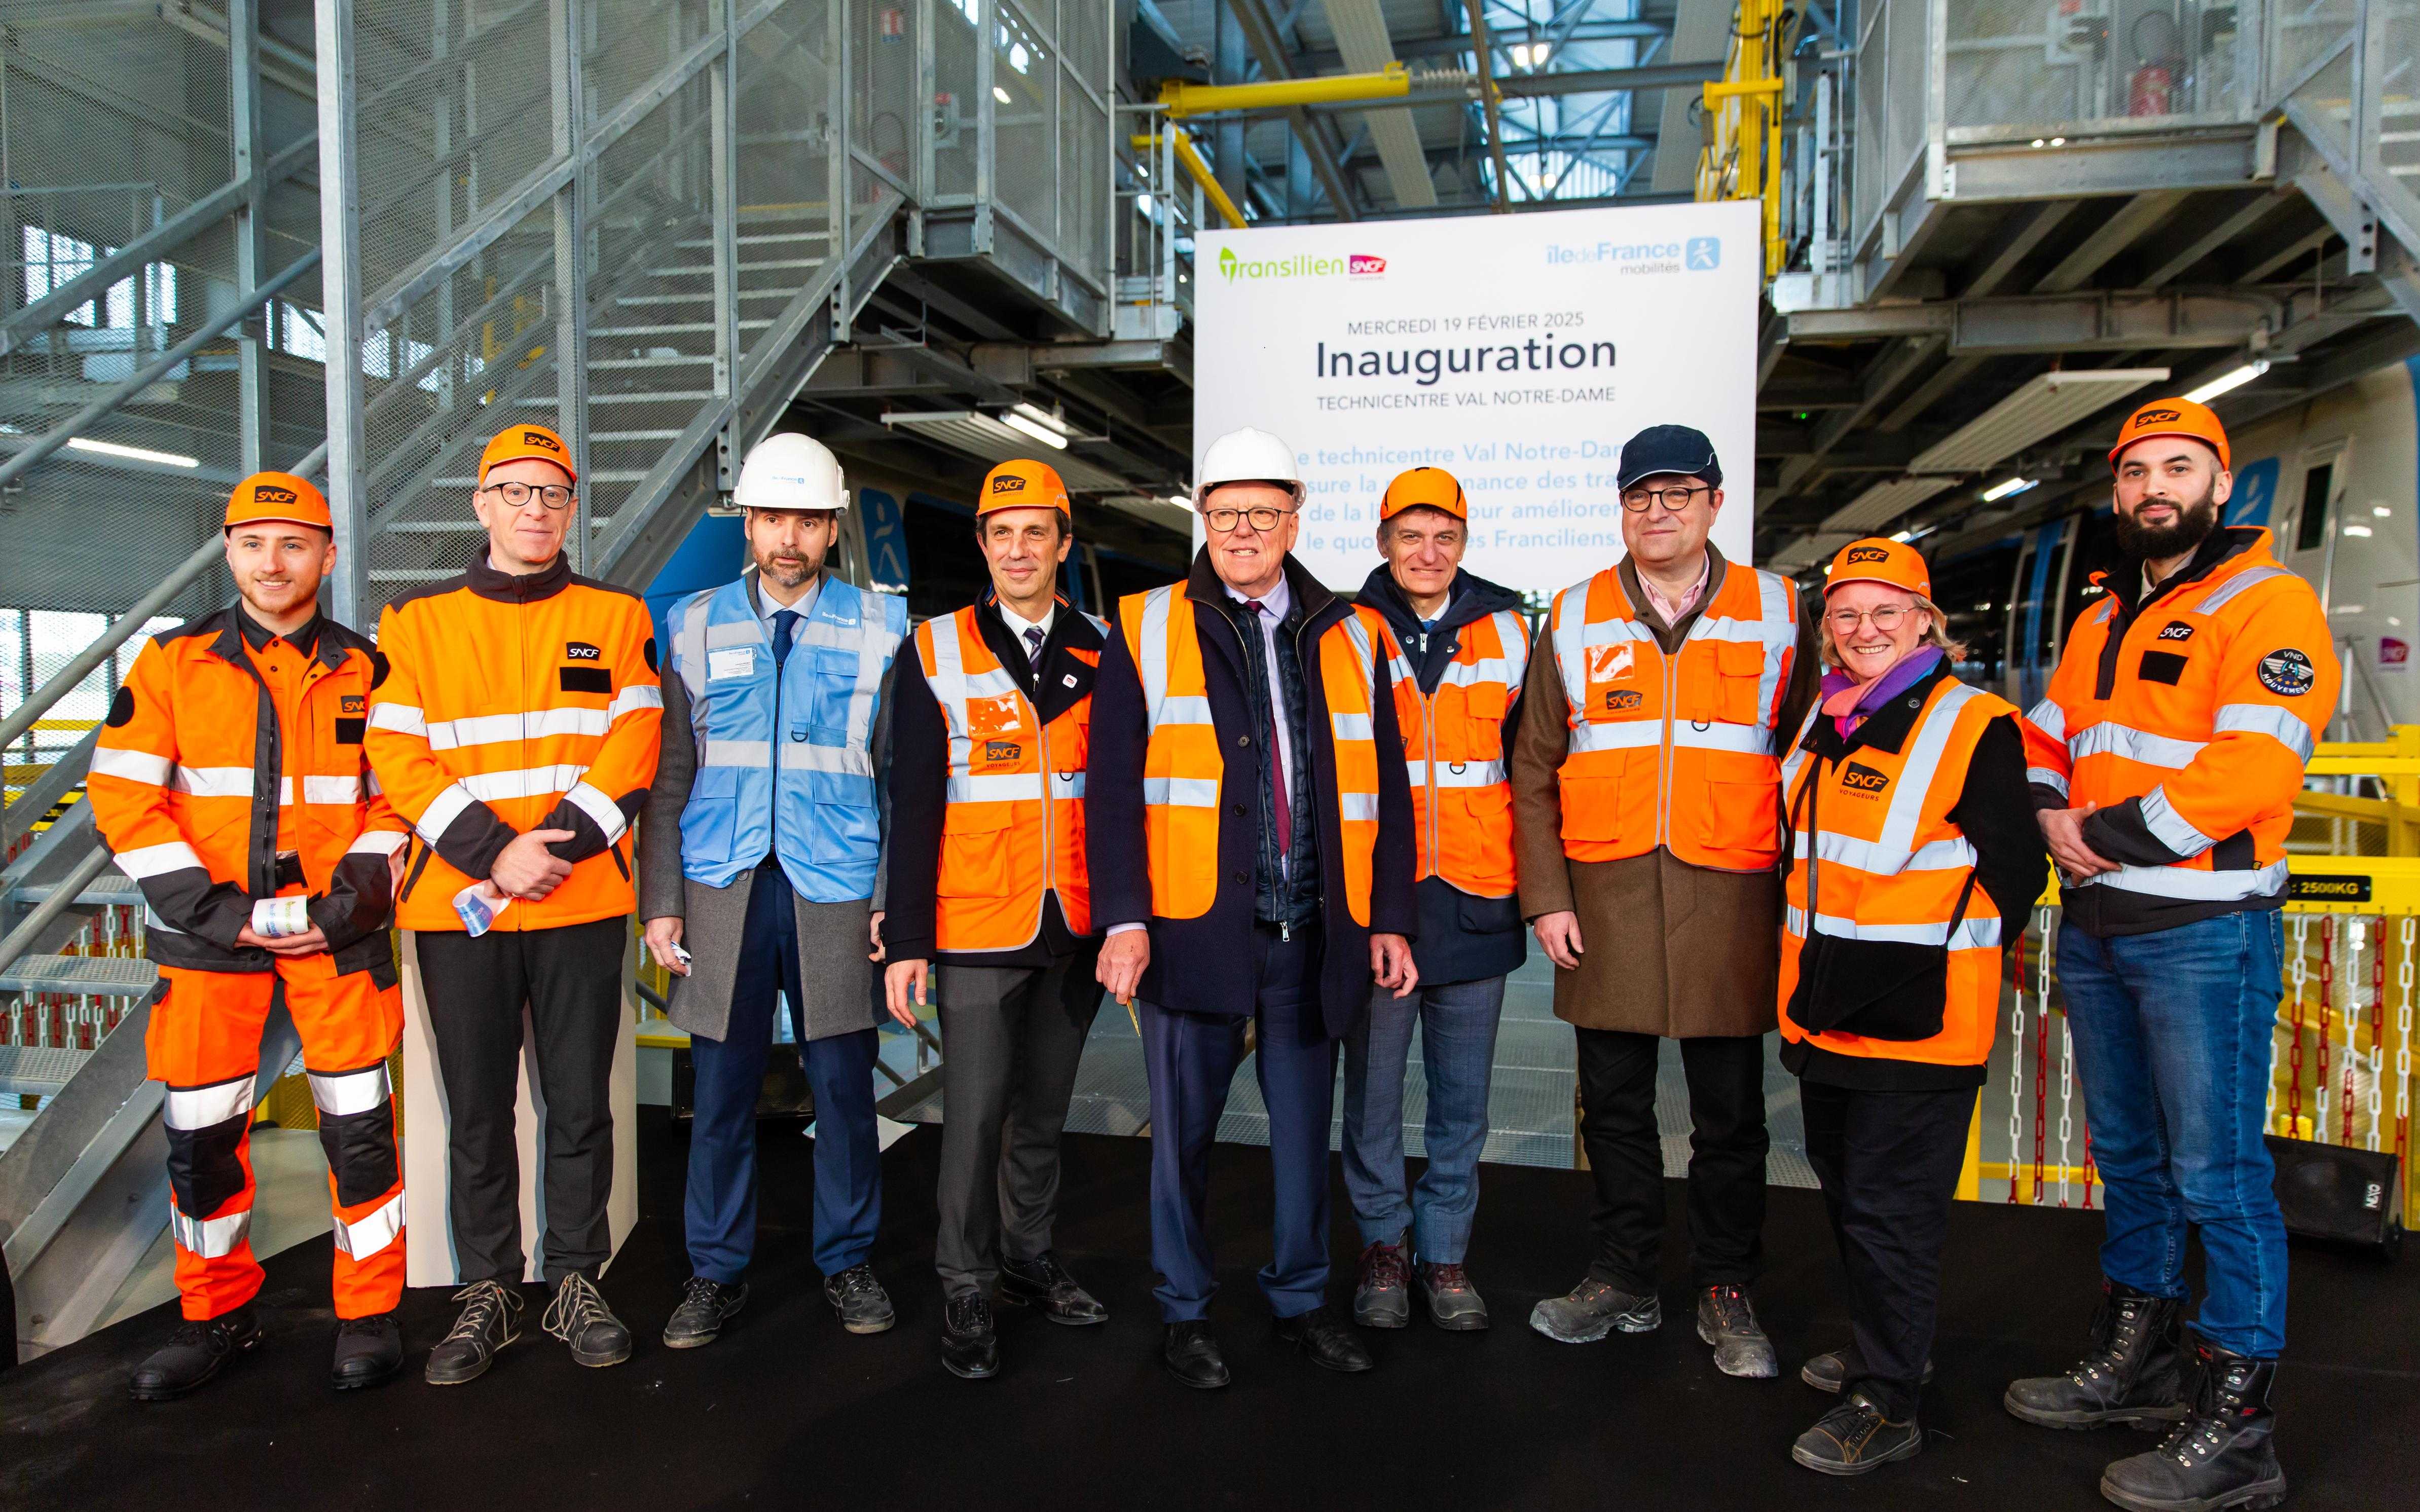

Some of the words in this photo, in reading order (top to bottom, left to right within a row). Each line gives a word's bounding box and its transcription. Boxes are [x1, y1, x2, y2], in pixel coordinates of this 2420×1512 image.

[1218, 246, 1343, 284] Transilien
[1350, 259, 1386, 274] SNCF
[1621, 261, 1680, 276] mobilités
[1347, 319, 1436, 335] MERCREDI
[1444, 318, 1461, 331] 19
[1468, 314, 1537, 330] FÉVRIER
[1544, 311, 1584, 328] 2025
[1317, 333, 1616, 385] Inauguration
[1317, 393, 1450, 410] TECHNICENTRE
[1455, 391, 1487, 406] VAL
[1494, 387, 1616, 405] NOTRE-DAME
[2136, 412, 2179, 427] SNCF
[526, 436, 559, 449] SNCF
[1298, 452, 1310, 465] e
[1317, 445, 1455, 465] technicentre
[1463, 442, 1496, 461] Val
[994, 479, 1024, 492] SNCF
[1307, 480, 1351, 494] sure
[1360, 473, 1377, 492] la
[1536, 471, 1577, 490] des
[1585, 472, 1617, 487] tra
[255, 491, 296, 501] SNCF
[1309, 504, 1335, 522] de
[1344, 503, 1362, 520] la
[1370, 501, 1380, 520] li
[1467, 507, 1504, 519] our
[1512, 499, 1622, 519] améliorer
[1306, 532, 1324, 549] le
[1333, 534, 1374, 554] quo
[1466, 535, 1486, 548] es
[1494, 529, 1622, 547] Franciliens.
[1849, 550, 1887, 563] SNCF
[2159, 627, 2192, 638] SNCF
[568, 648, 599, 657] SNCF
[2262, 673, 2309, 693] MOUVEMENT
[1608, 694, 1640, 708] SNCF
[987, 747, 1020, 759] SNCF
[1844, 771, 1886, 788] SNCF
[1839, 788, 1880, 801] VOYAGEURS
[2300, 881, 2360, 895] 2500KG
